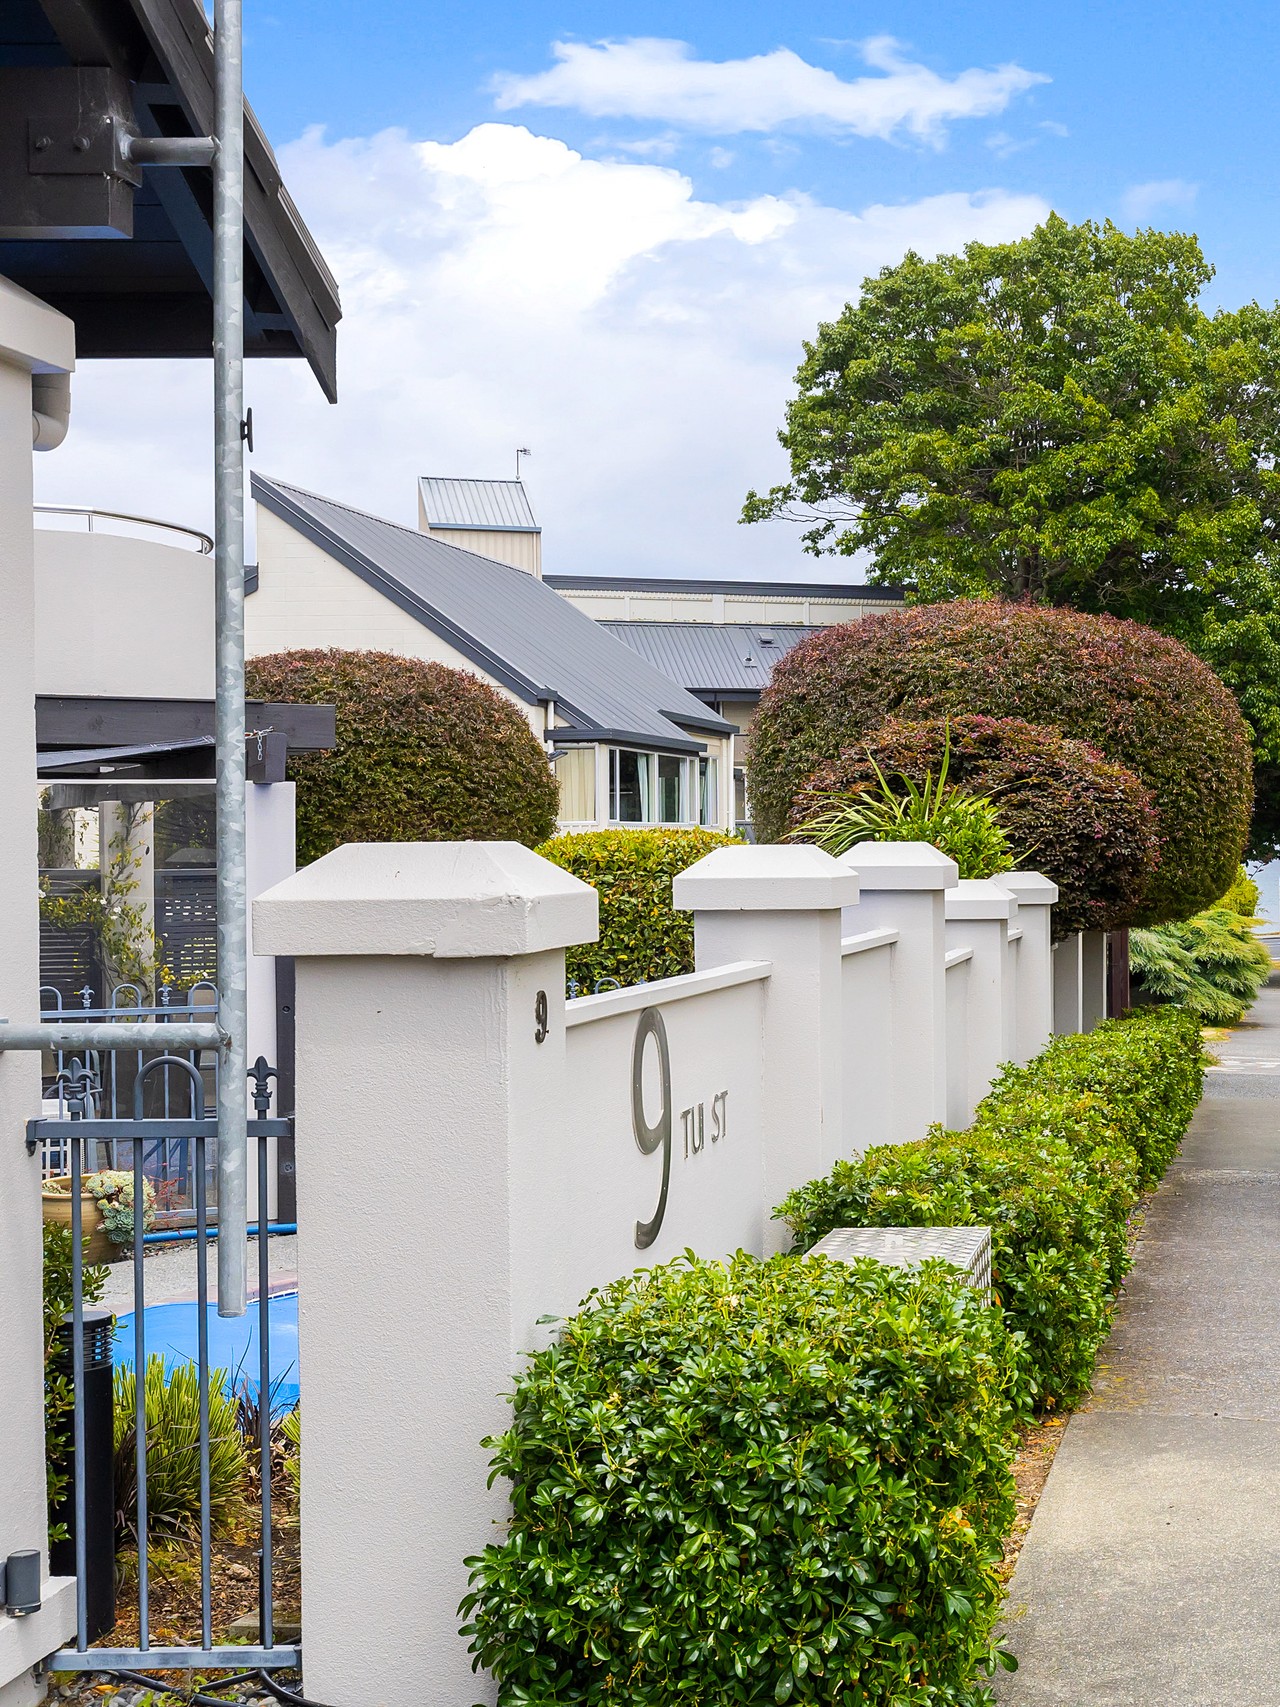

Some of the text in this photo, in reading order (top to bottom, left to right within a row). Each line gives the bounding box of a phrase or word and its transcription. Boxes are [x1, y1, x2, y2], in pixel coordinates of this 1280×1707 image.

[534, 989, 548, 1045] 9
[631, 1007, 673, 1250] 9
[680, 1090, 729, 1160] TUI ST
